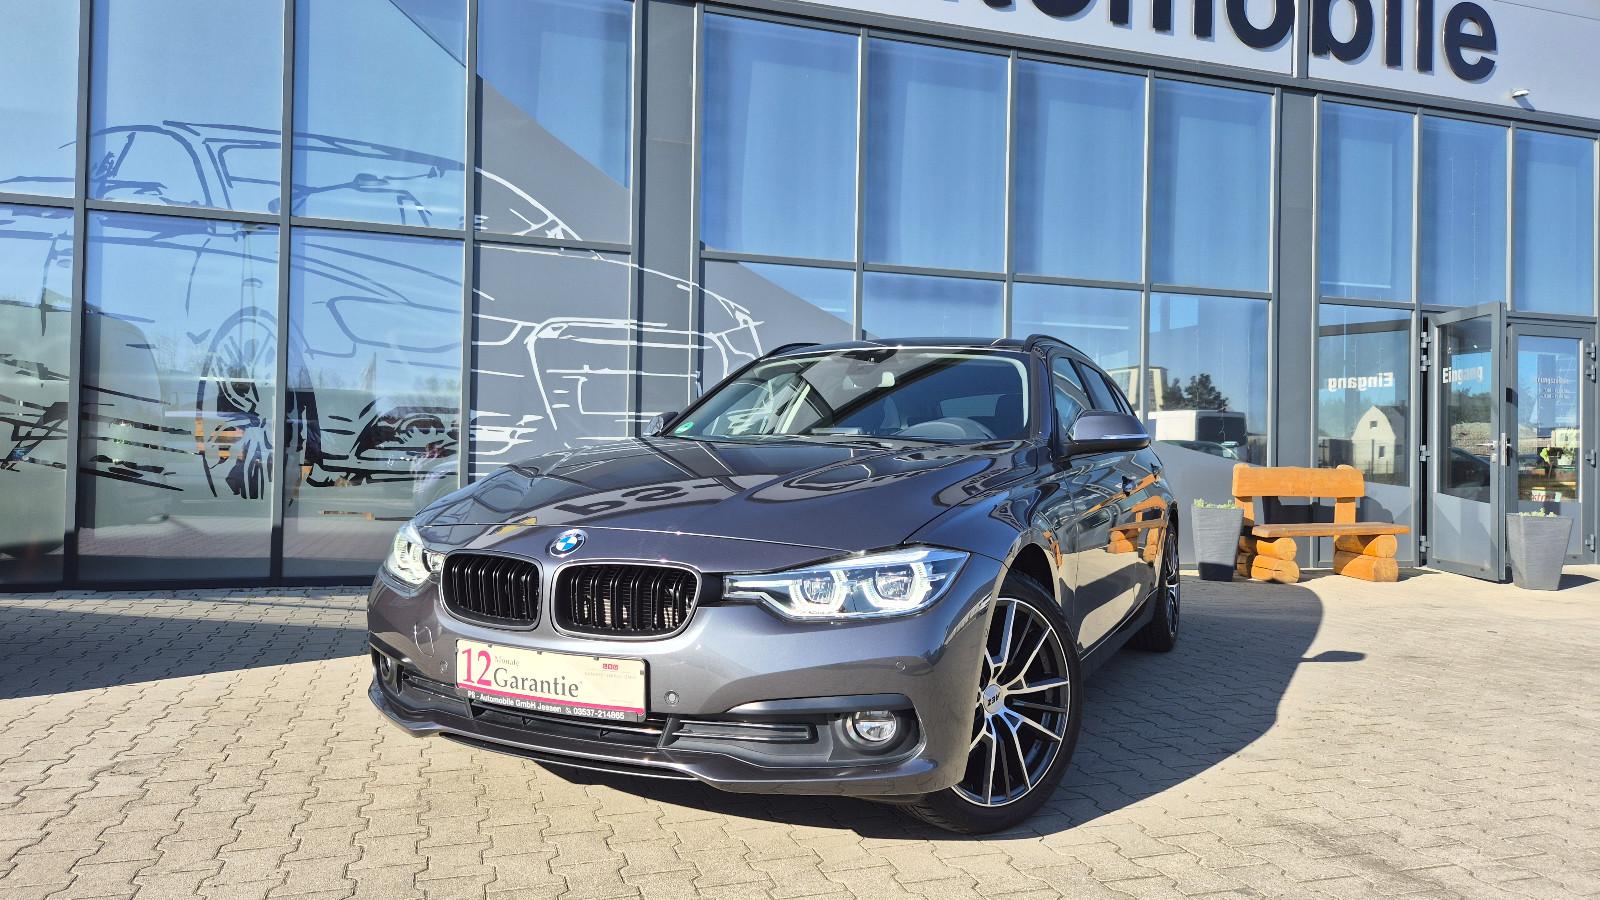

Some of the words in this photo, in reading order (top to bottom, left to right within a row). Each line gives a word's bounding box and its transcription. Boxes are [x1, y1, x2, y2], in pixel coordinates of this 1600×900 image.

[983, 0, 1497, 81] obile
[461, 647, 492, 687] 12
[493, 667, 580, 698] Garantie
[479, 693, 514, 706] Automobile
[515, 699, 537, 709] GmbH
